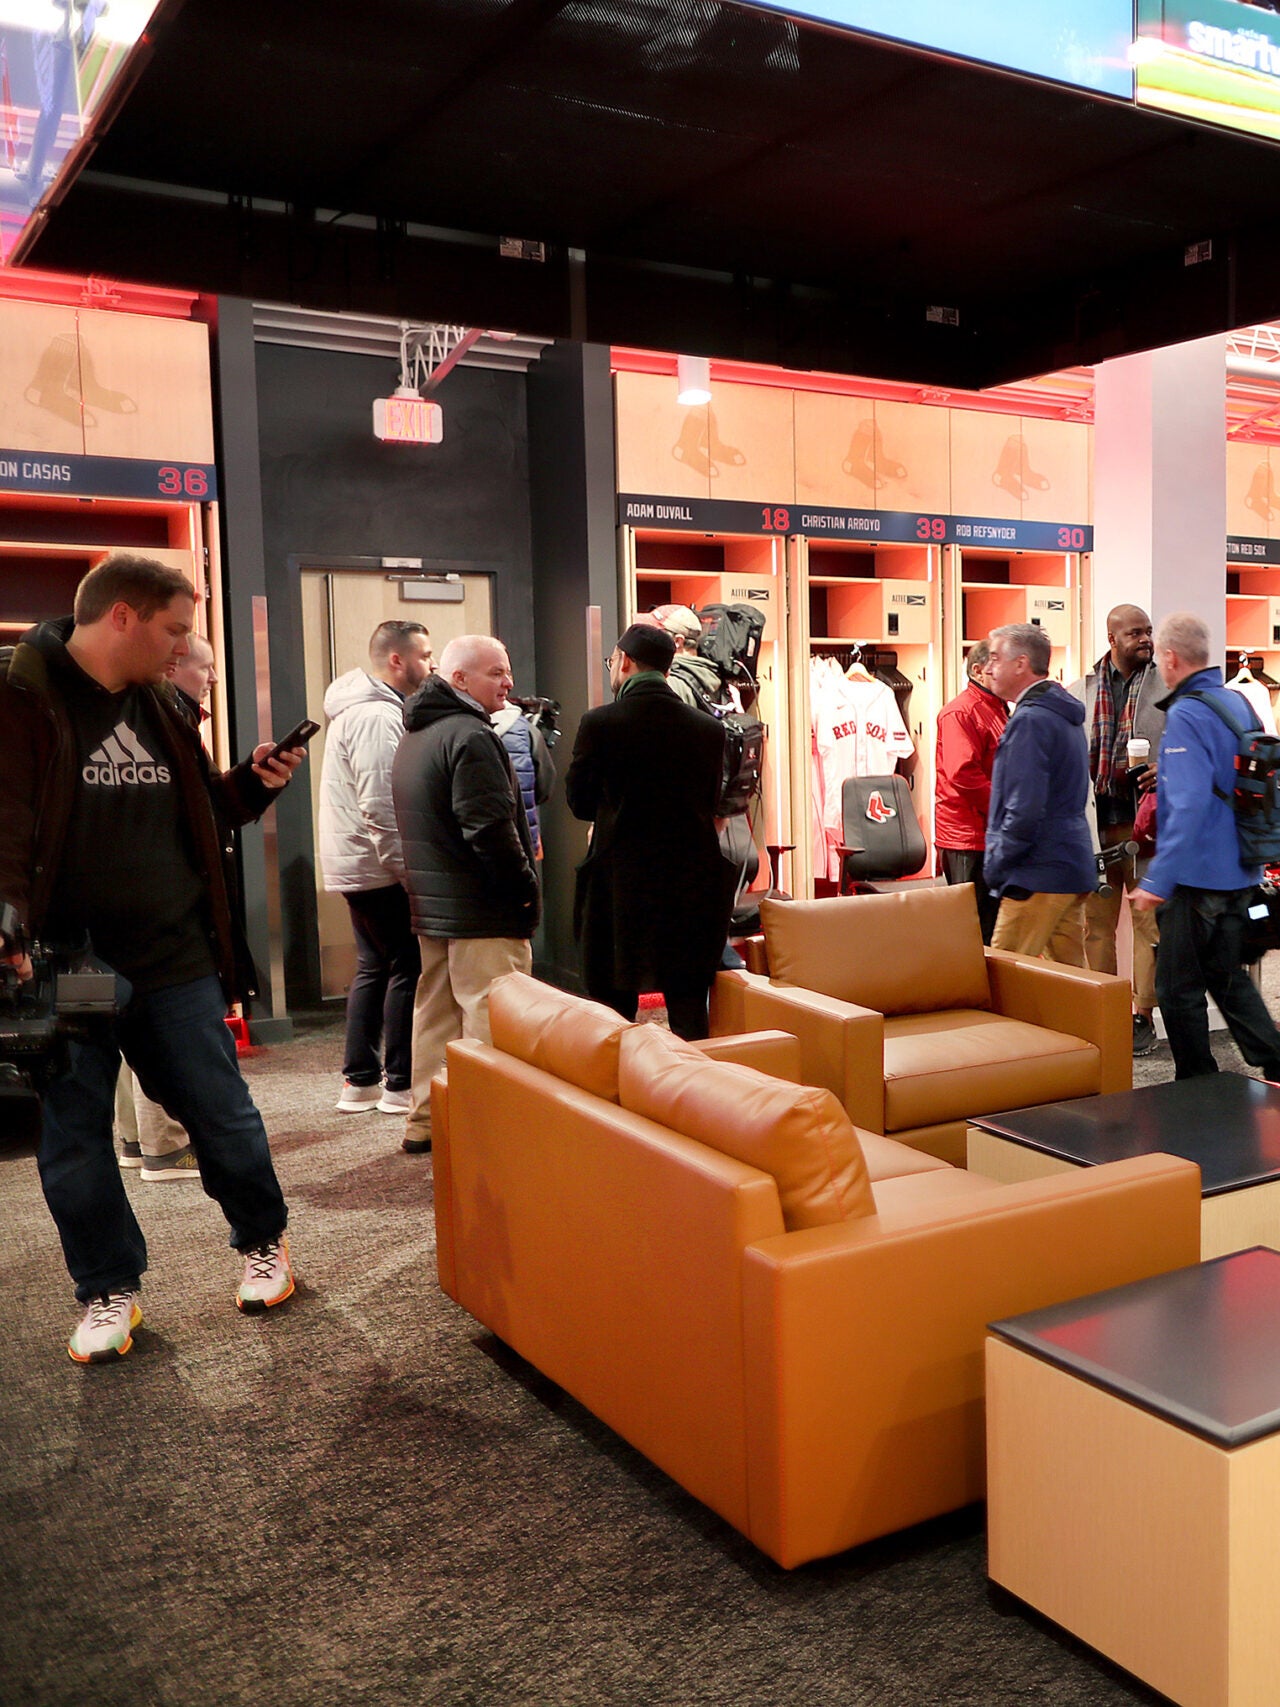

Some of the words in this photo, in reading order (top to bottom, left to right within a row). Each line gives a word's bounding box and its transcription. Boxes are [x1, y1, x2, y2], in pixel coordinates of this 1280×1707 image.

[385, 401, 434, 440] EXIT
[23, 462, 72, 482] CASAS
[158, 467, 209, 496] 36
[626, 503, 655, 518] ADAM
[656, 504, 693, 521] DUVALL
[761, 507, 790, 531] 18
[801, 514, 845, 530] CHRISTIAN
[847, 517, 881, 532] ARROYO
[916, 517, 946, 540] 39
[956, 524, 972, 538] ROB
[973, 525, 1017, 540] REFSNYDER
[1057, 528, 1085, 548] 30
[1240, 543, 1253, 554] RED
[1253, 544, 1266, 556] SOX
[832, 720, 857, 741] RED
[865, 721, 888, 743] SOX
[82, 761, 171, 786] adidas
